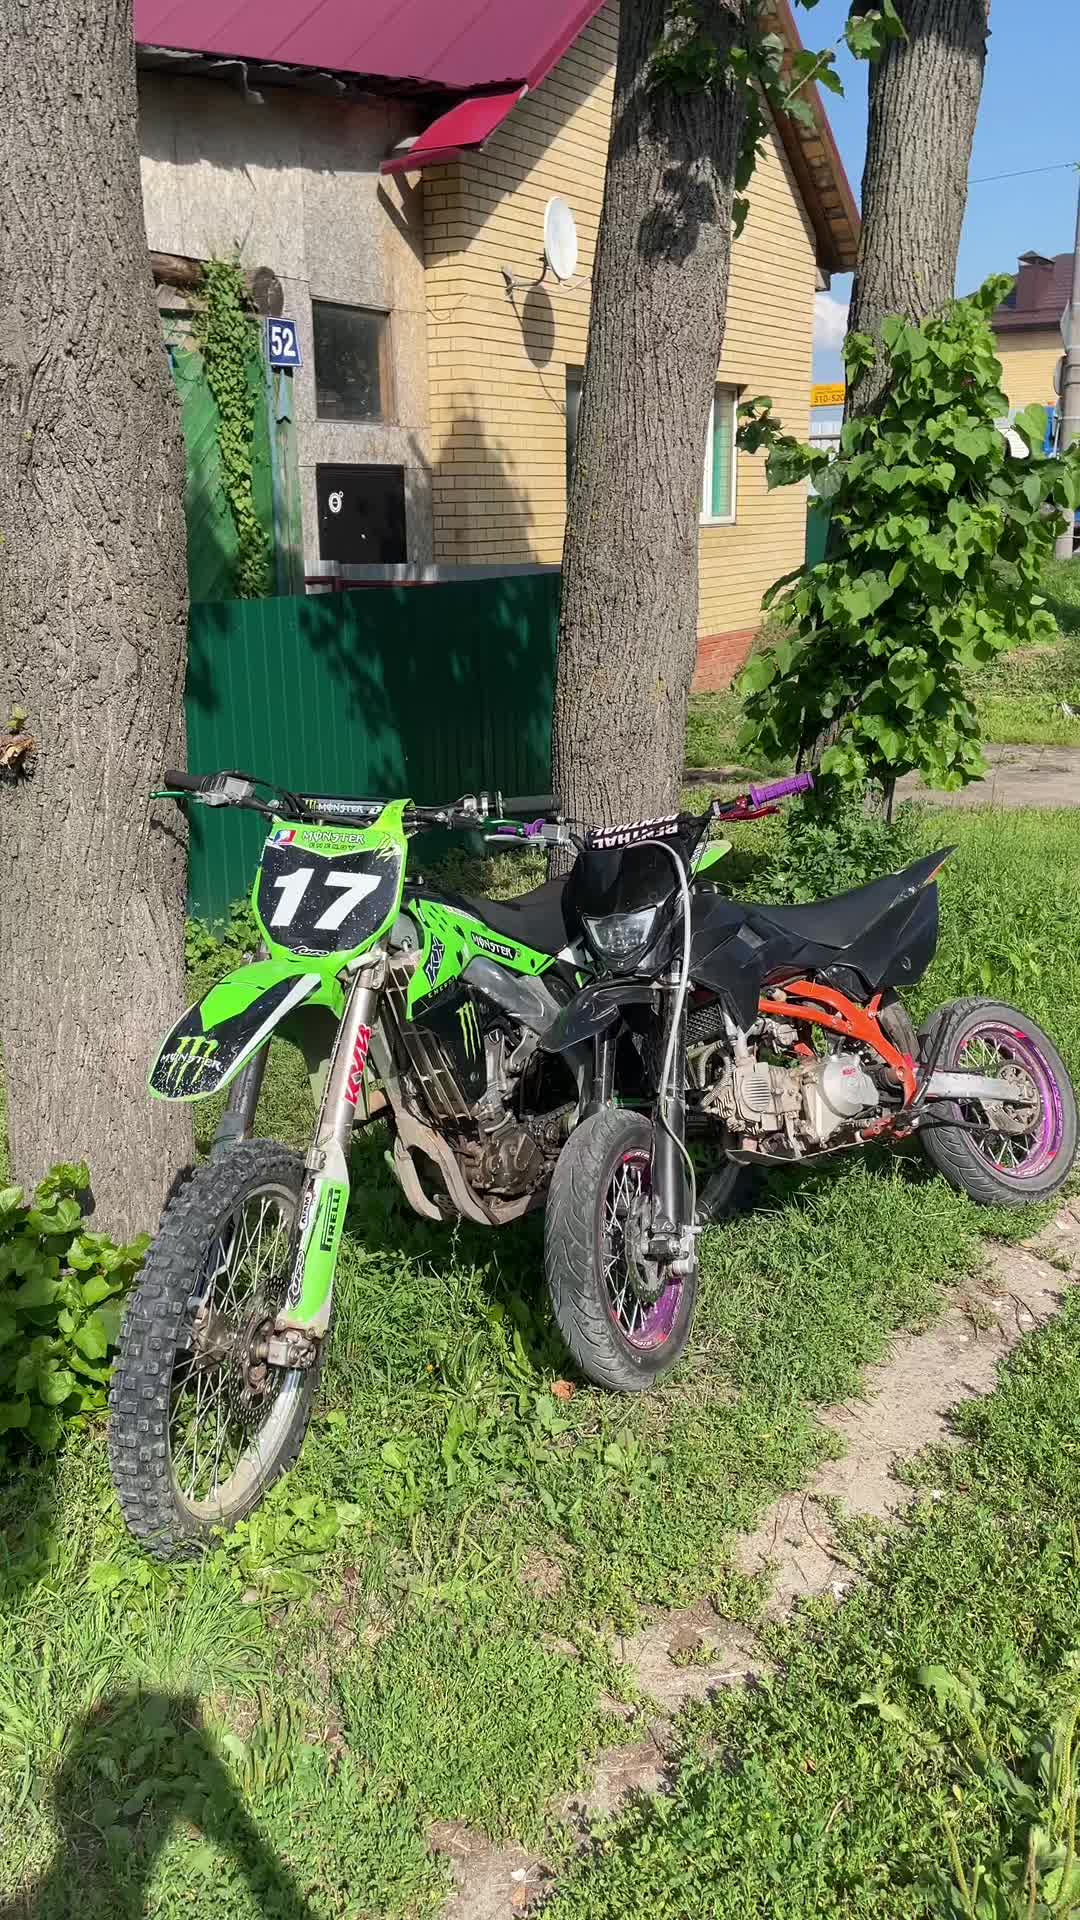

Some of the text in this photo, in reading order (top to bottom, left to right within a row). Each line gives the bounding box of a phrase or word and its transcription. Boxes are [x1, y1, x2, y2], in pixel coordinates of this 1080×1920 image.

[272, 326, 296, 357] 52
[318, 802, 364, 814] MONSTER
[303, 830, 365, 844] MONSTER
[592, 813, 680, 837] RENTHAL
[592, 823, 679, 849] RENTHAL
[269, 867, 382, 931] 17
[472, 933, 514, 960] MONSTER
[161, 1052, 224, 1073] MONSTER
[320, 1188, 341, 1252] PIRELLI
